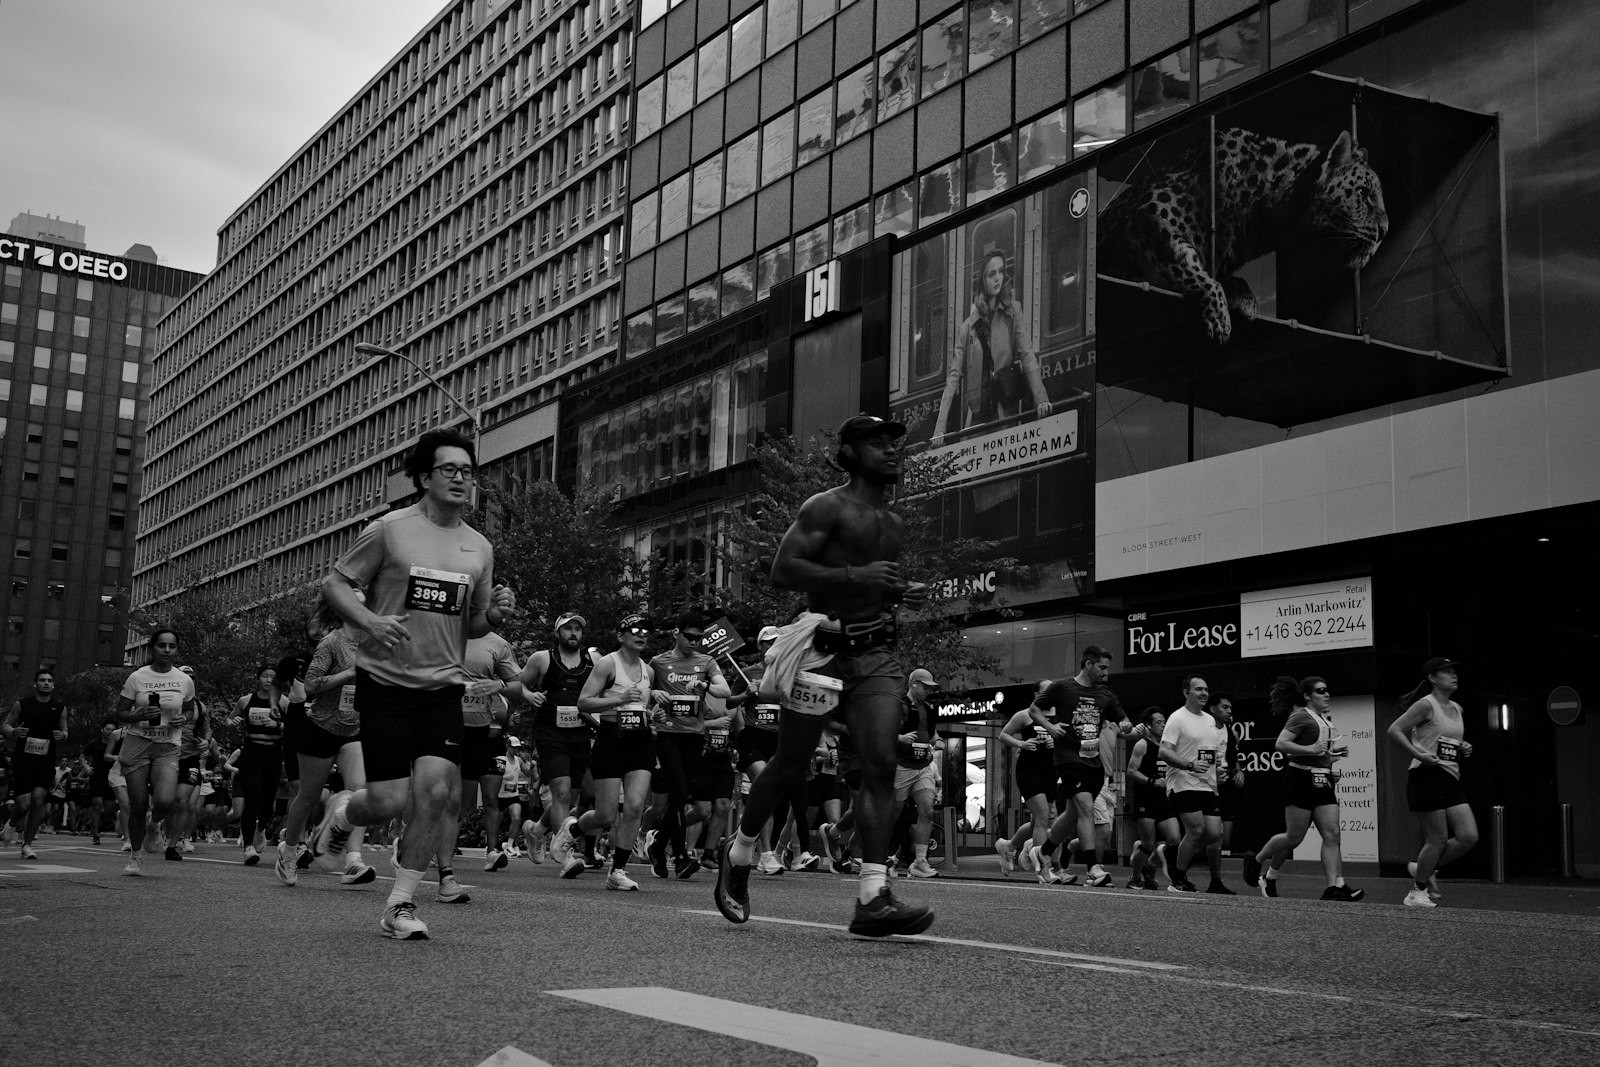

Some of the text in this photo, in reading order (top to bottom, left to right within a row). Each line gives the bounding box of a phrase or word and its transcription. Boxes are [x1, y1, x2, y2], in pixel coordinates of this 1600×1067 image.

[59, 251, 128, 281] OEEO
[804, 259, 842, 323] 151
[983, 427, 1042, 452] MONTBLANC
[1122, 533, 1202, 554] BLOOR STREET WEST
[412, 586, 448, 603] 3898
[1345, 583, 1367, 594] Retail
[1128, 612, 1147, 622] CBRE
[1275, 604, 1302, 618] Arlin
[1246, 614, 1367, 641] +1 416 362 2244
[701, 628, 727, 646] 4:00
[1128, 622, 1237, 656] For Lease
[672, 704, 691, 712] 4580
[621, 715, 641, 724] 7300
[1229, 716, 1256, 741] or
[1351, 730, 1373, 739] Retail
[1237, 751, 1284, 772] ease
[1350, 820, 1375, 832] 2244
